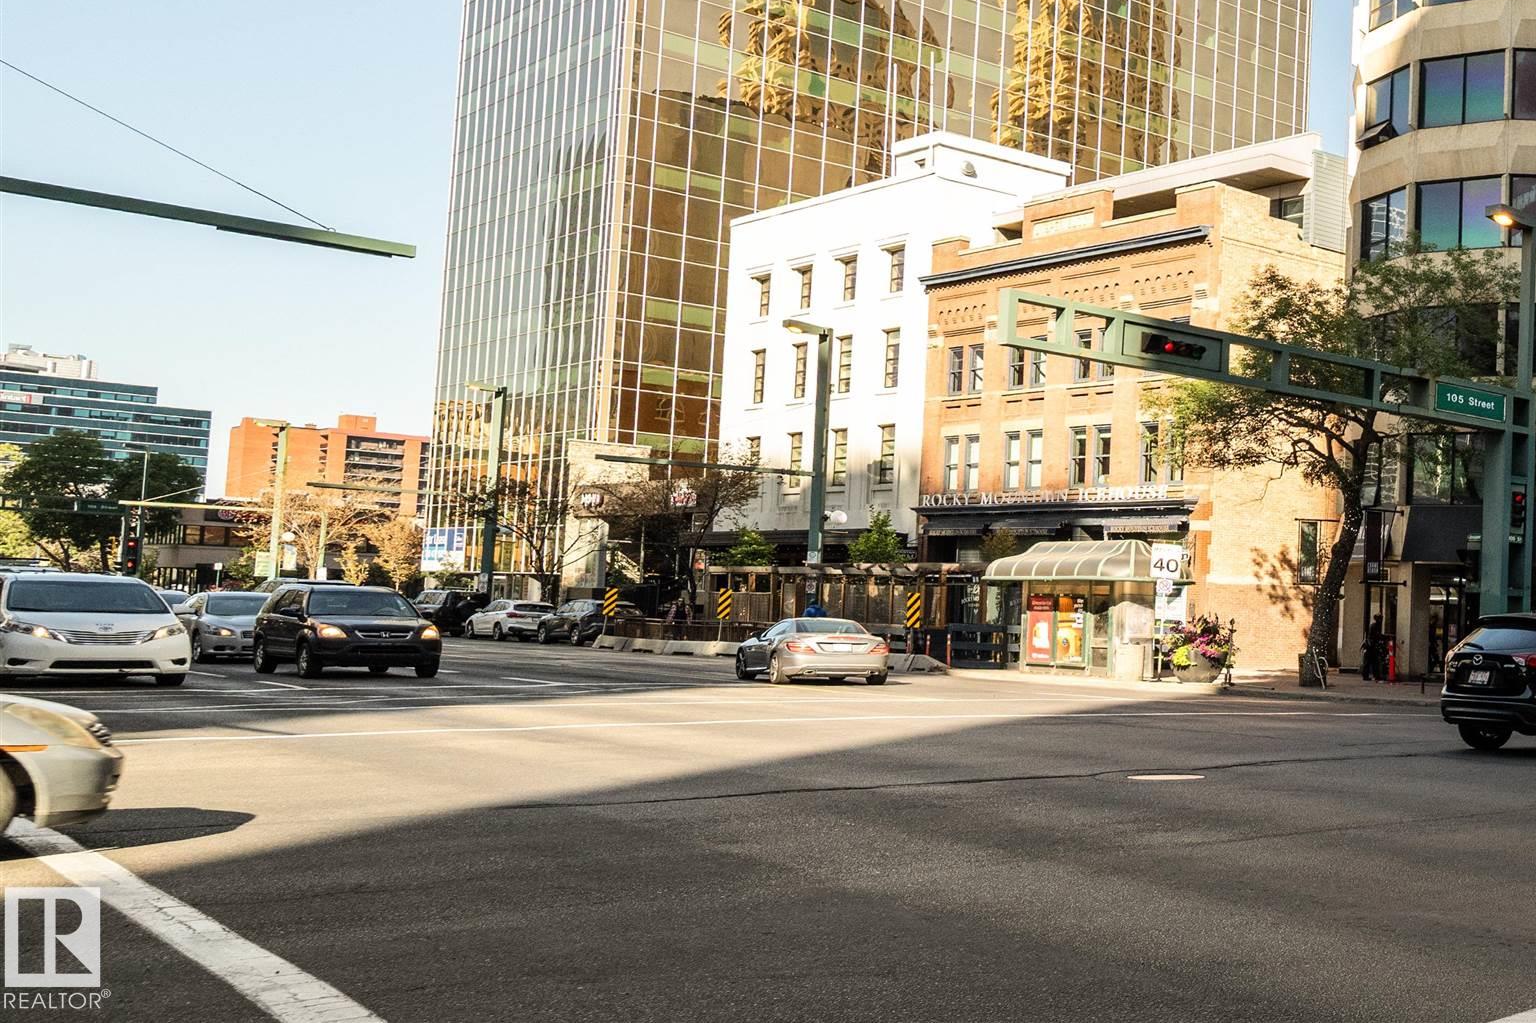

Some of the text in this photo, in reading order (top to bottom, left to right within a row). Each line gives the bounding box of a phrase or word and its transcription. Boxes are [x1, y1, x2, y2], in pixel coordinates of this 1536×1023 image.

[1446, 392, 1495, 410] 105 Street
[923, 493, 970, 507] ROCKY
[1153, 557, 1179, 573] 40
